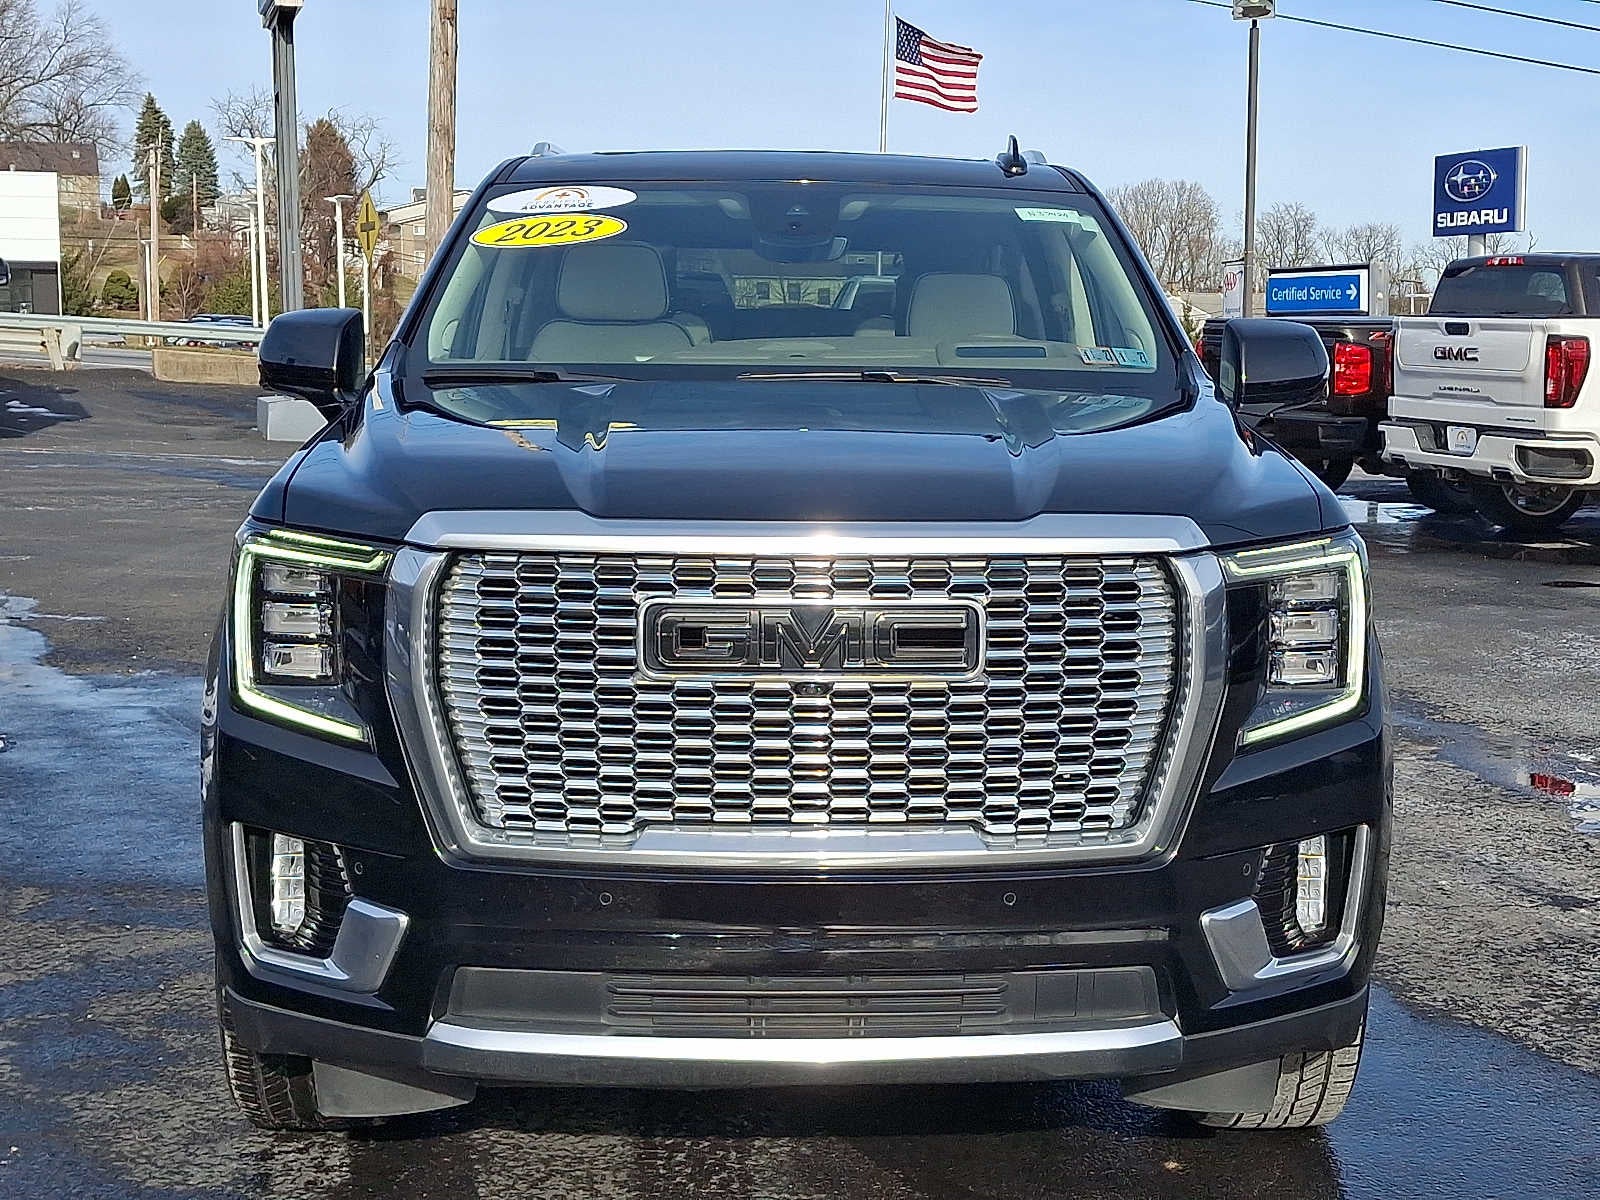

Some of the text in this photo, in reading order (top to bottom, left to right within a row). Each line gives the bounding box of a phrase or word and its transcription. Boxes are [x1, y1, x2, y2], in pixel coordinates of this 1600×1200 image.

[521, 202, 593, 211] ADVANTAGE
[1437, 208, 1508, 228] SUBARU
[495, 219, 604, 243] 2023
[1271, 285, 1342, 301] Certified Service
[1434, 346, 1479, 361] GMC
[656, 609, 968, 668] GMC
